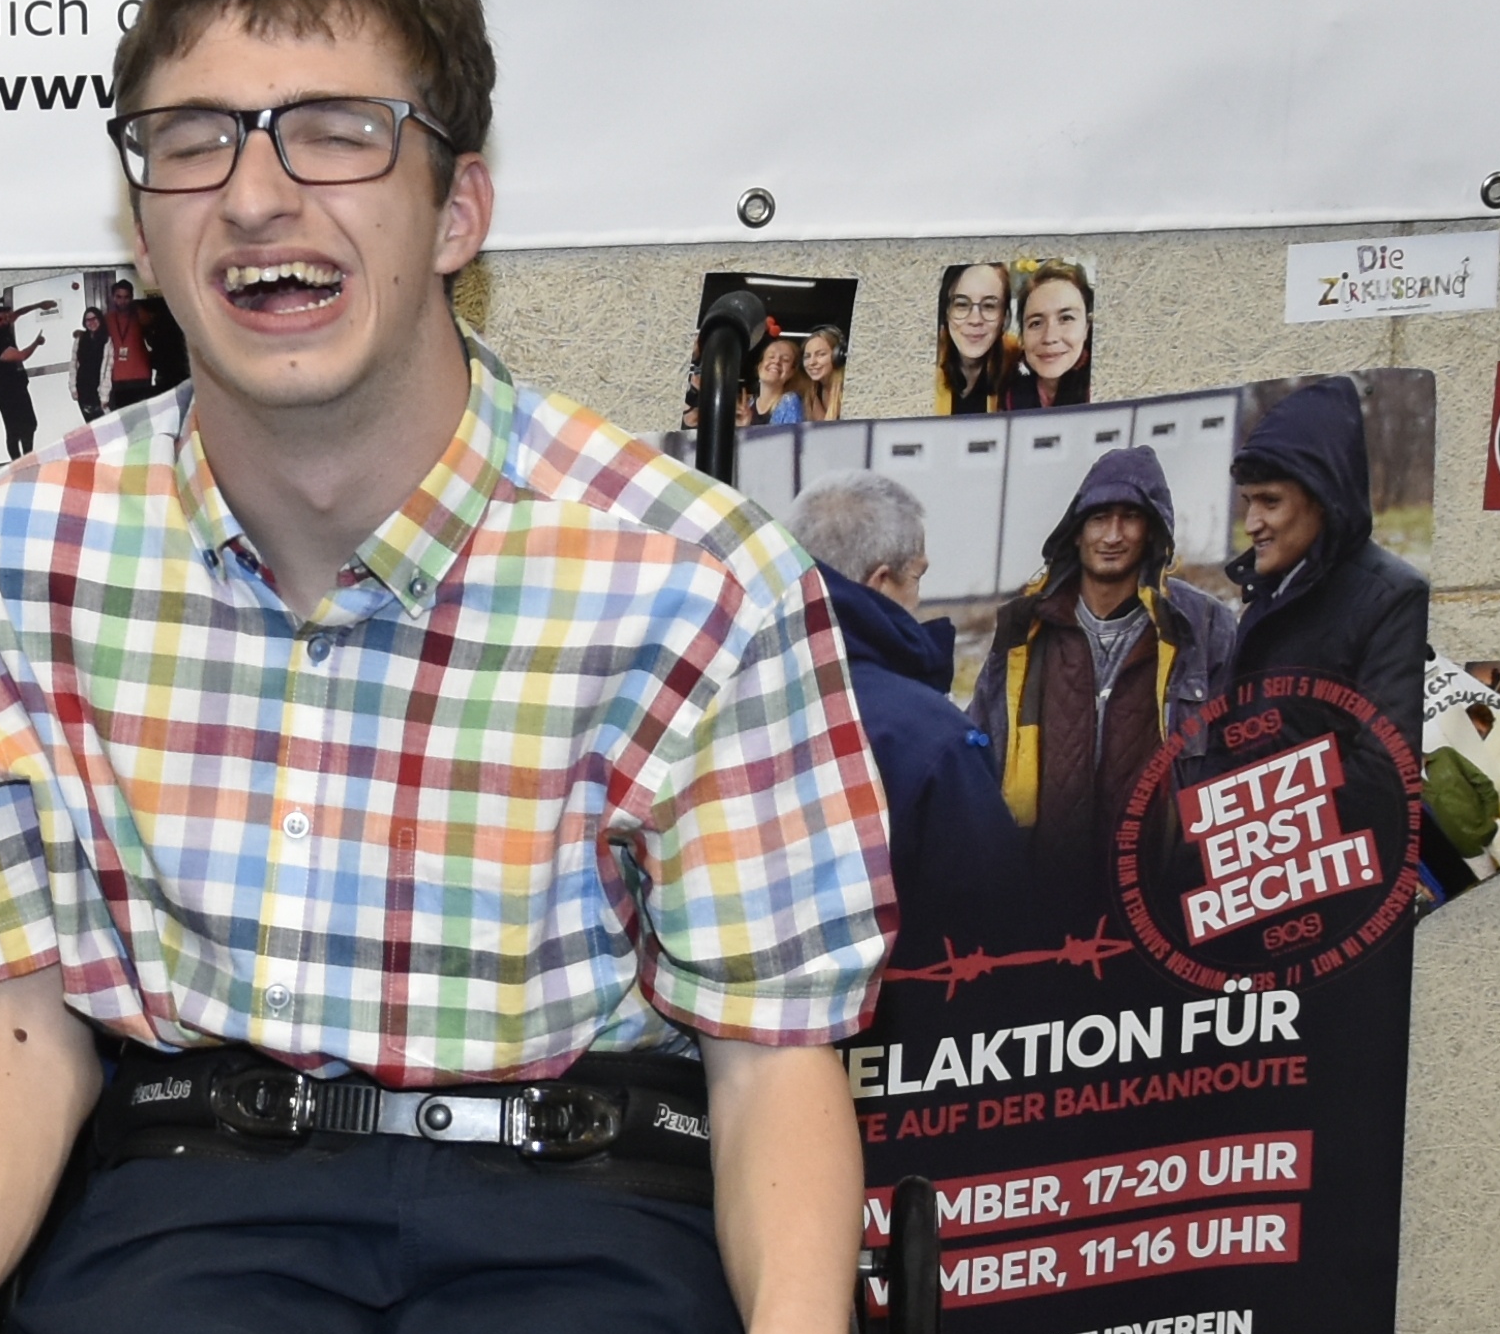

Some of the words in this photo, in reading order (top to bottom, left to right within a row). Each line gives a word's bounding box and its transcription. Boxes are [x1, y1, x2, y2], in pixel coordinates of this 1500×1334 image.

[1357, 244, 1405, 275] Die
[1223, 707, 1283, 748] SOS
[1262, 675, 1293, 698] SEIT
[1312, 678, 1378, 723] WINTERN
[1190, 740, 1331, 834] JETZT
[1115, 817, 1139, 849] FÜR
[1205, 794, 1328, 880] ERST
[1117, 849, 1138, 887] WIR
[1187, 836, 1375, 939] RECHT!
[1263, 912, 1323, 950] SOS
[850, 1005, 1164, 1099] ELAKTION
[1180, 978, 1301, 1055] FÜR
[896, 1103, 968, 1139] AUF
[977, 1094, 1045, 1129] DER
[1054, 1055, 1308, 1119] BALKANROUTE
[1082, 1154, 1187, 1207] 17-20
[1197, 1140, 1298, 1187] UHR
[1079, 1228, 1176, 1274] 11-16
[1185, 1214, 1287, 1259] UHR
